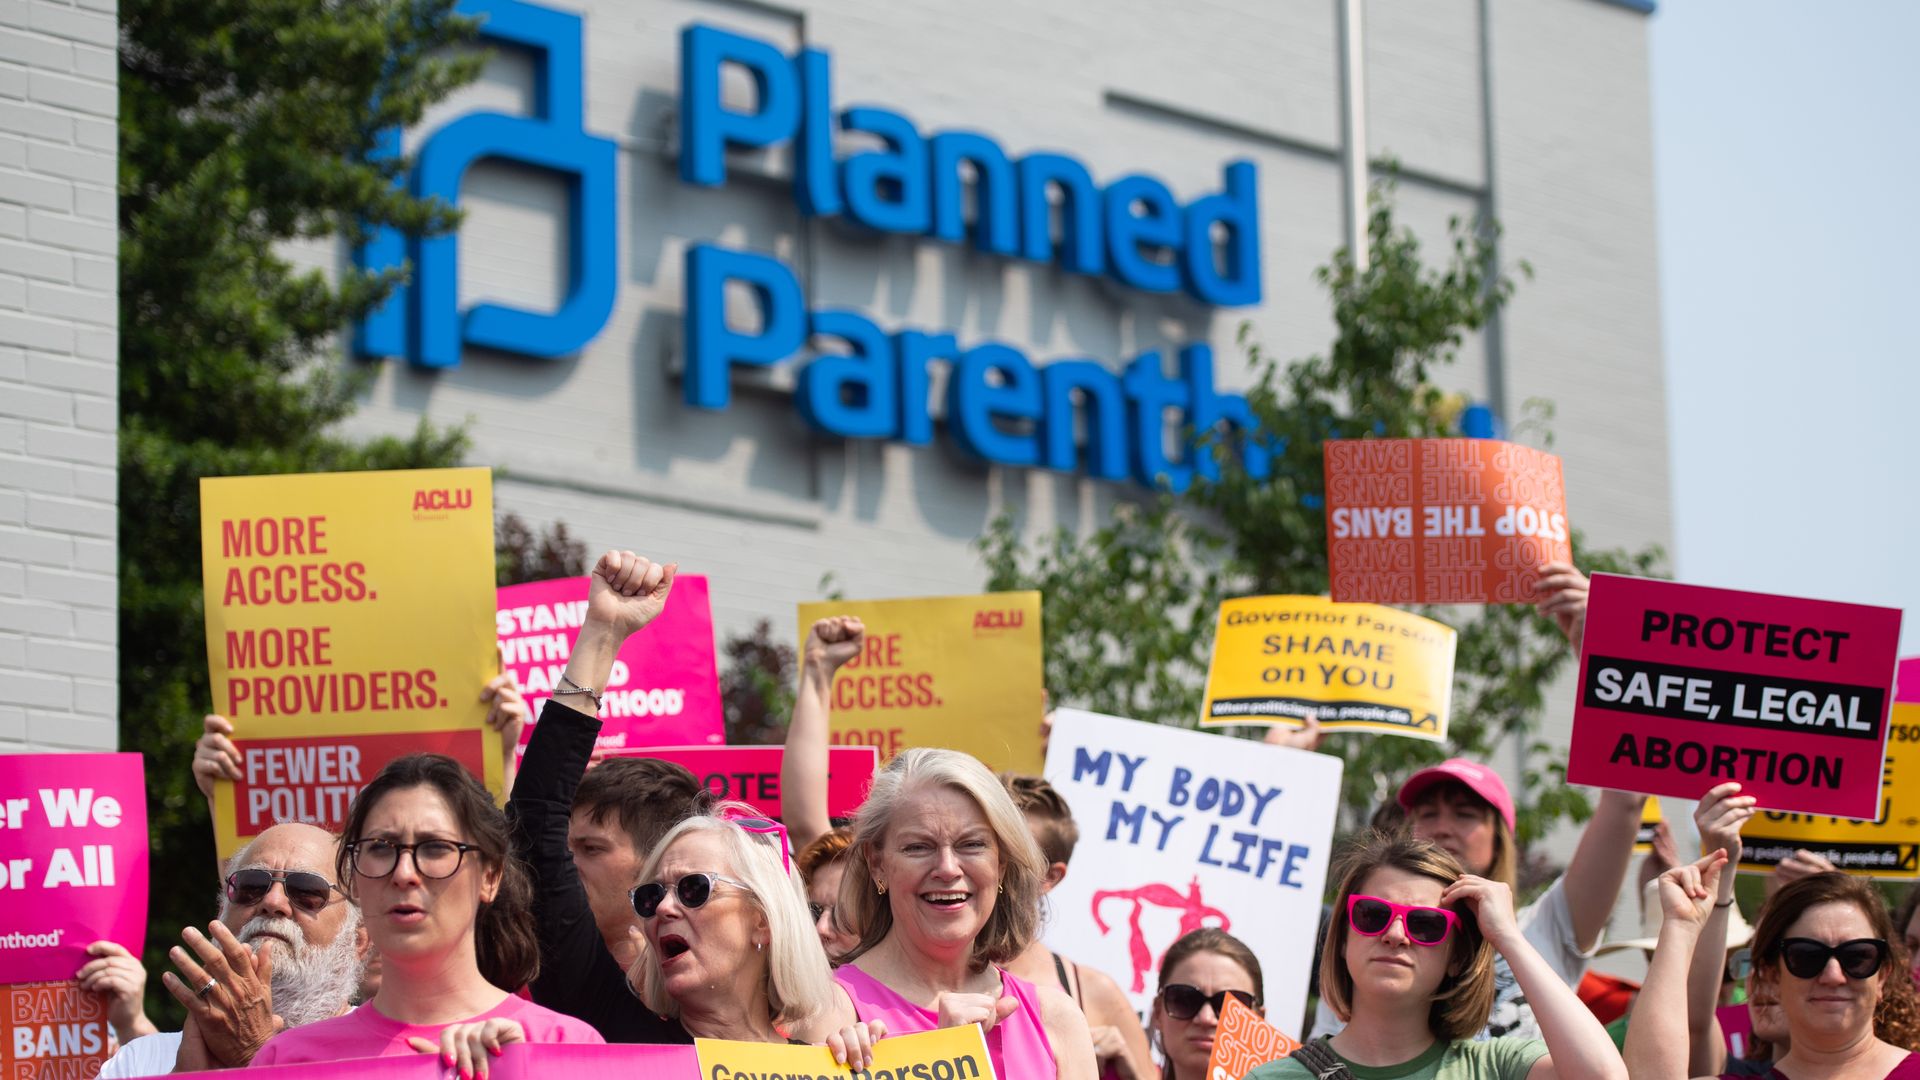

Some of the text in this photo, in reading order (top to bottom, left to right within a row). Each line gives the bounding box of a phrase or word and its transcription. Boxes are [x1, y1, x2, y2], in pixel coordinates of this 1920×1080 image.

[678, 24, 1262, 307] Planned
[681, 242, 1288, 490] Parenth
[1328, 440, 1413, 473] BANS
[1422, 439, 1486, 472] THE
[413, 488, 472, 511] ACLU
[1330, 472, 1413, 505] BANS
[1422, 471, 1487, 505] THE
[222, 516, 328, 558] MORE
[1332, 505, 1567, 543] STOP THE BANS
[1333, 539, 1416, 572] BANS
[1424, 538, 1487, 570] THE
[223, 562, 377, 606] ACCESS.
[1335, 569, 1541, 603] OP THE BANS
[973, 609, 1024, 628] ACLU
[1226, 610, 1346, 626] Governor
[1641, 609, 1849, 663] PROTECT
[226, 627, 332, 669] MORE
[844, 633, 903, 670] RE
[1263, 634, 1395, 664] SHAME
[228, 670, 448, 717] PROVIDERS.
[1262, 664, 1395, 691] on YOU
[1594, 667, 1871, 731] SAFE, LEGAL
[246, 745, 362, 785] FEWER
[1610, 733, 1843, 789] ABORTION
[248, 785, 362, 826] POLITI
[1072, 747, 1283, 826] MY BODY
[38, 787, 122, 828] We
[1105, 801, 1309, 889] MY LIFE
[42, 844, 116, 889] All
[11, 988, 101, 1025] BANS
[13, 1022, 102, 1059] BANS
[1223, 1000, 1291, 1063] STOP
